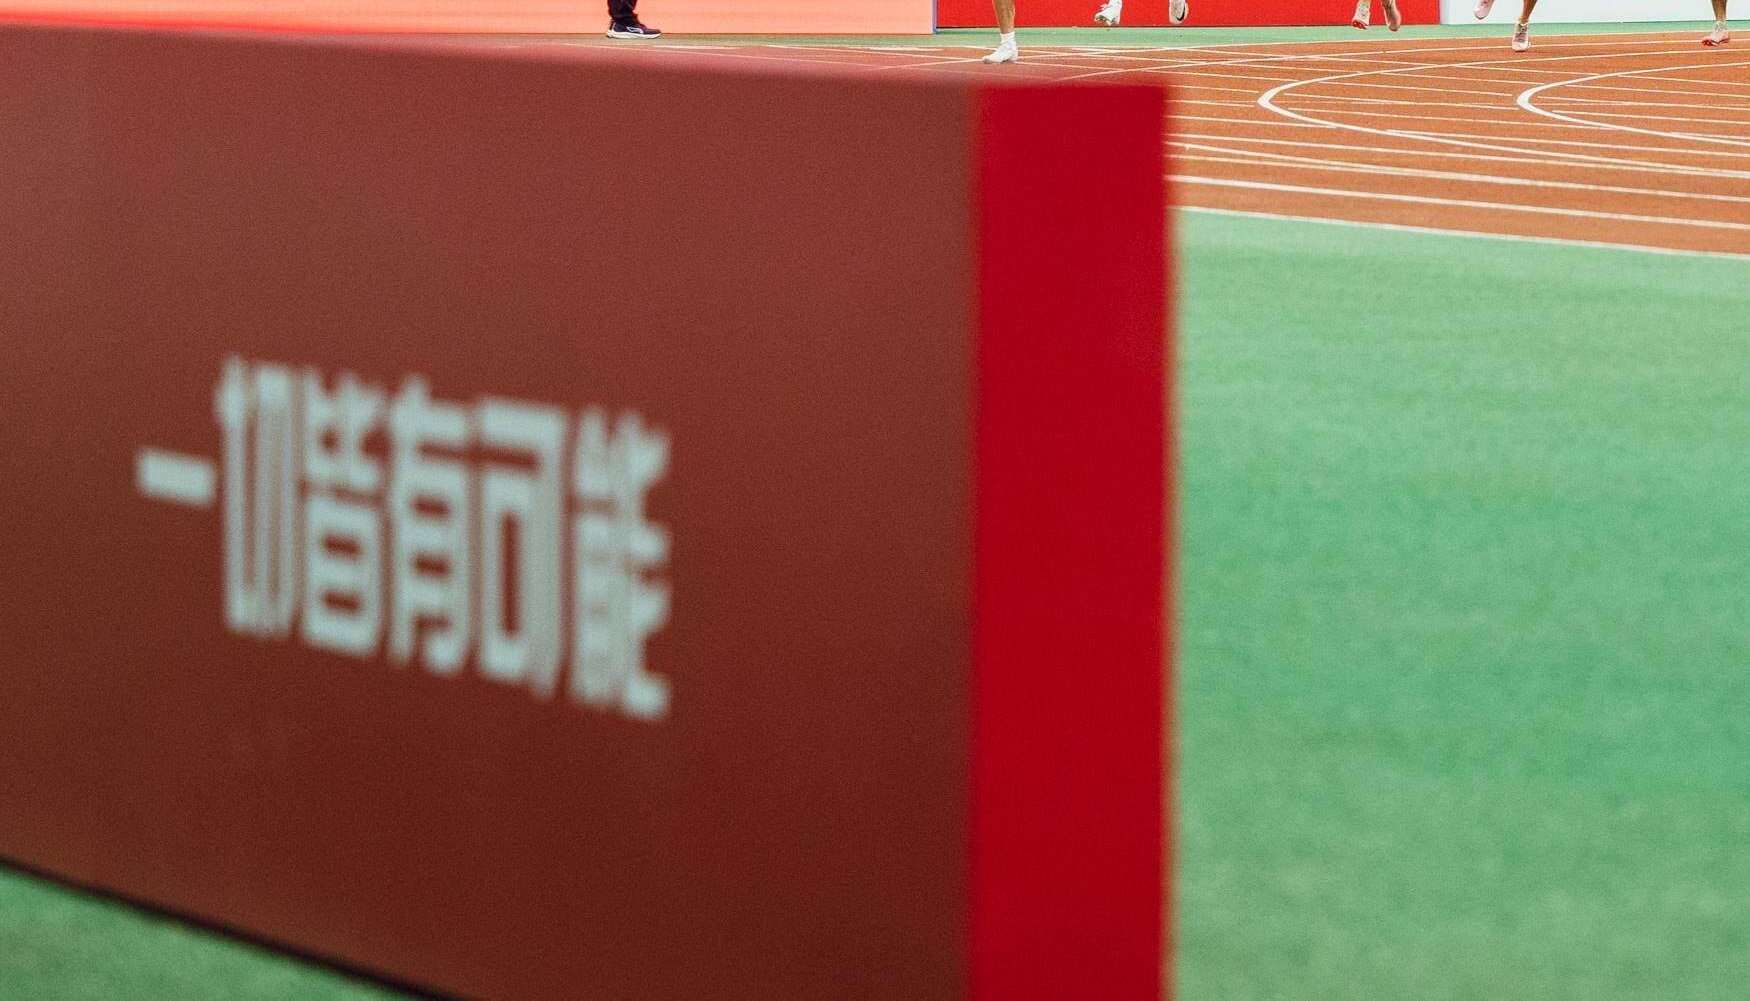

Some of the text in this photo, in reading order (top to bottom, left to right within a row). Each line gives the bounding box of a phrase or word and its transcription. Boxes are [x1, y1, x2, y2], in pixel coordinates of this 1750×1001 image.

[134, 354, 674, 723] 一切皆有可能
